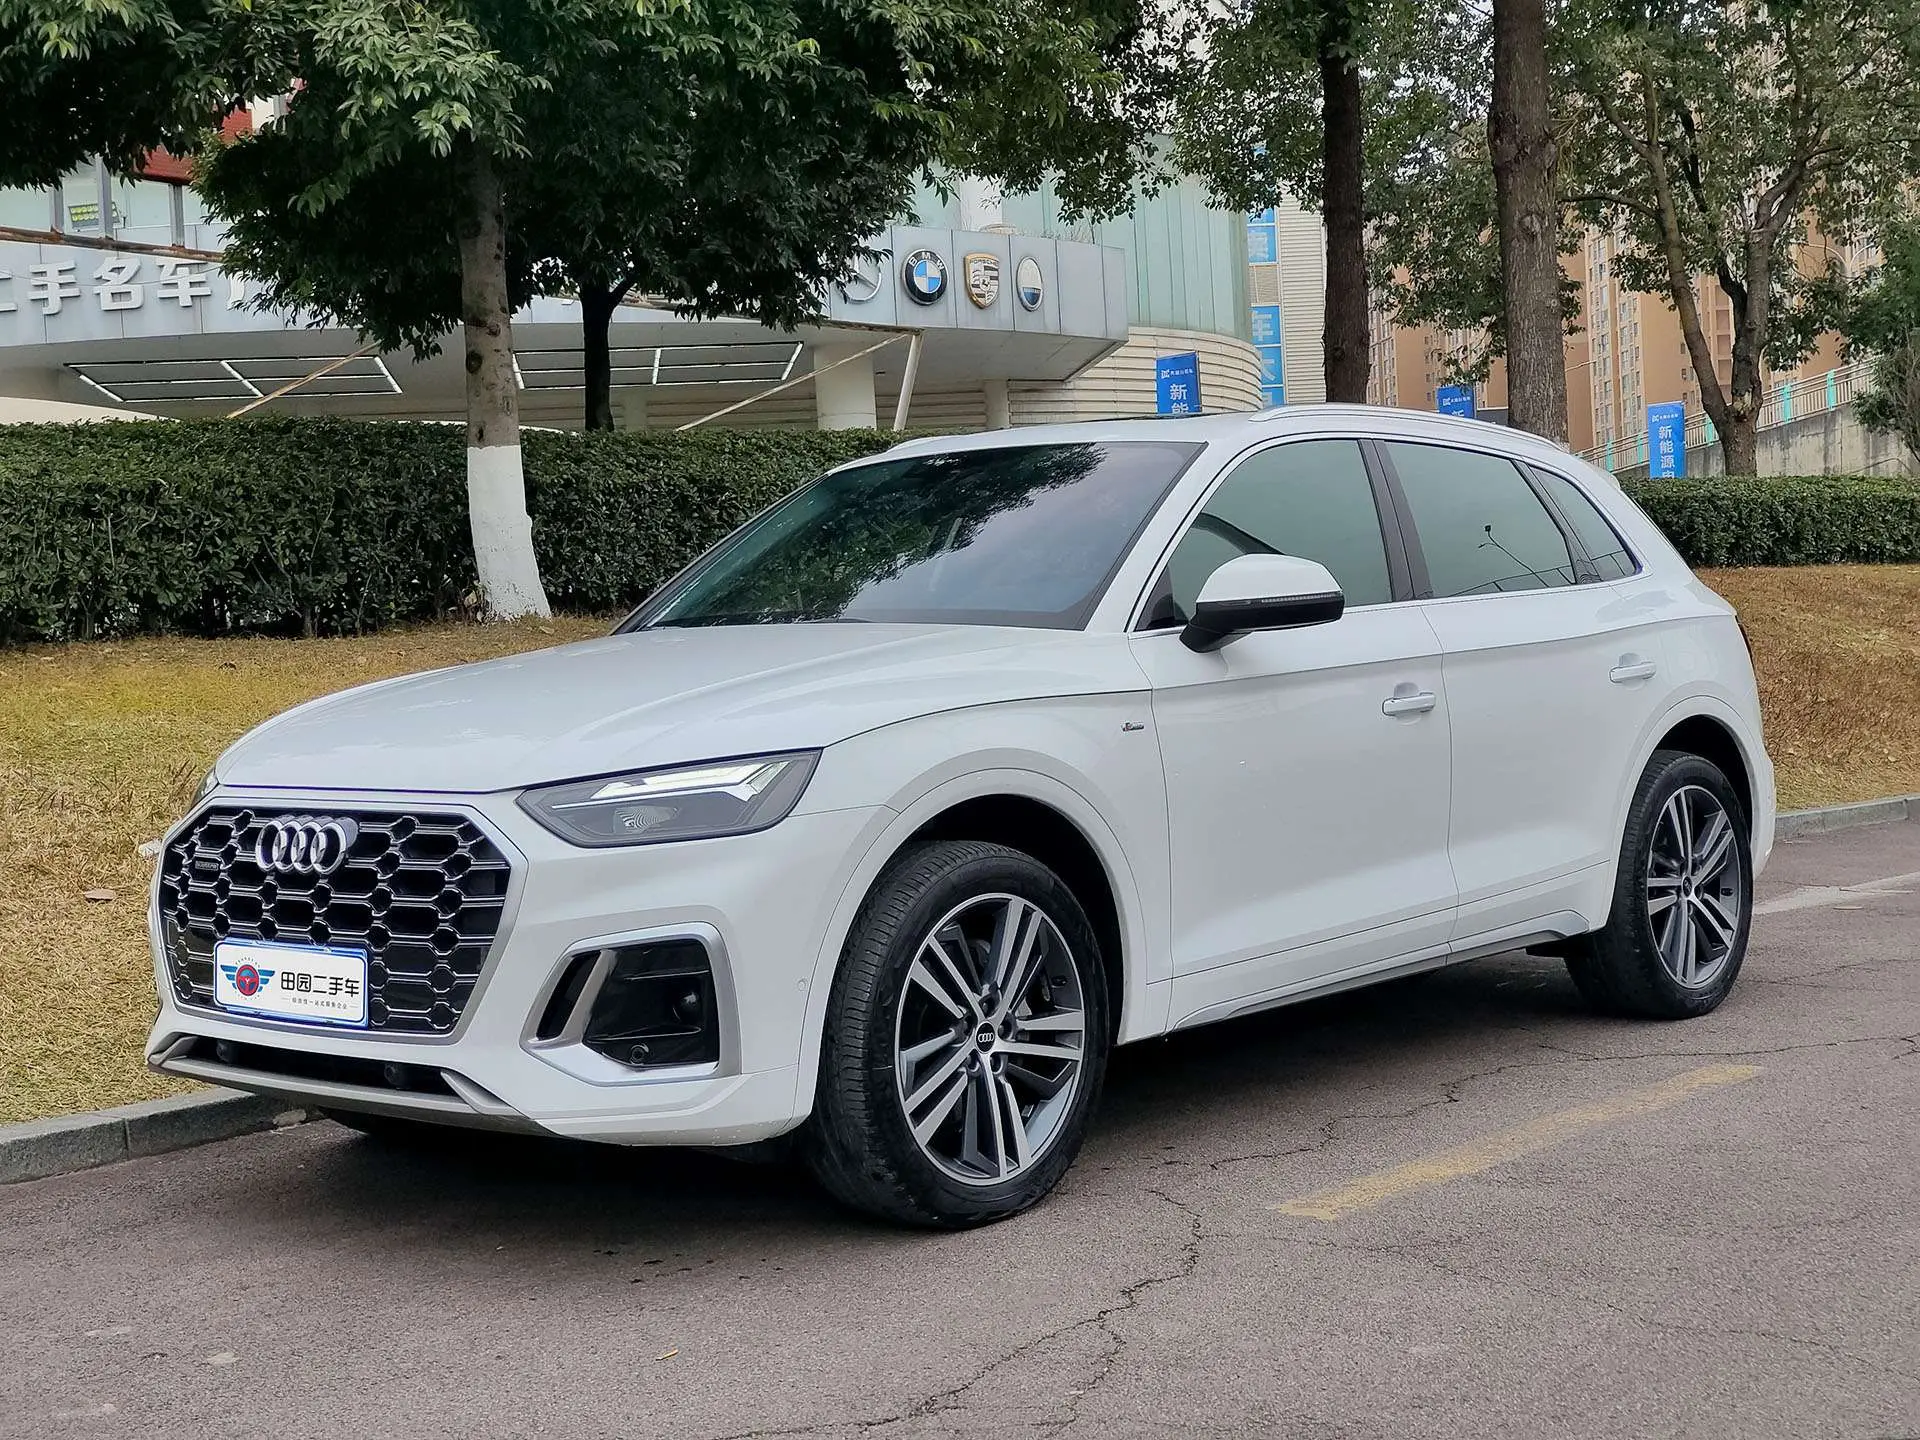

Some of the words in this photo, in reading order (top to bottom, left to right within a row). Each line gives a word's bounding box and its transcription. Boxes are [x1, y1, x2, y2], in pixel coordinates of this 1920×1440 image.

[909, 252, 945, 270] BMW
[281, 971, 360, 998] 田园二手车
